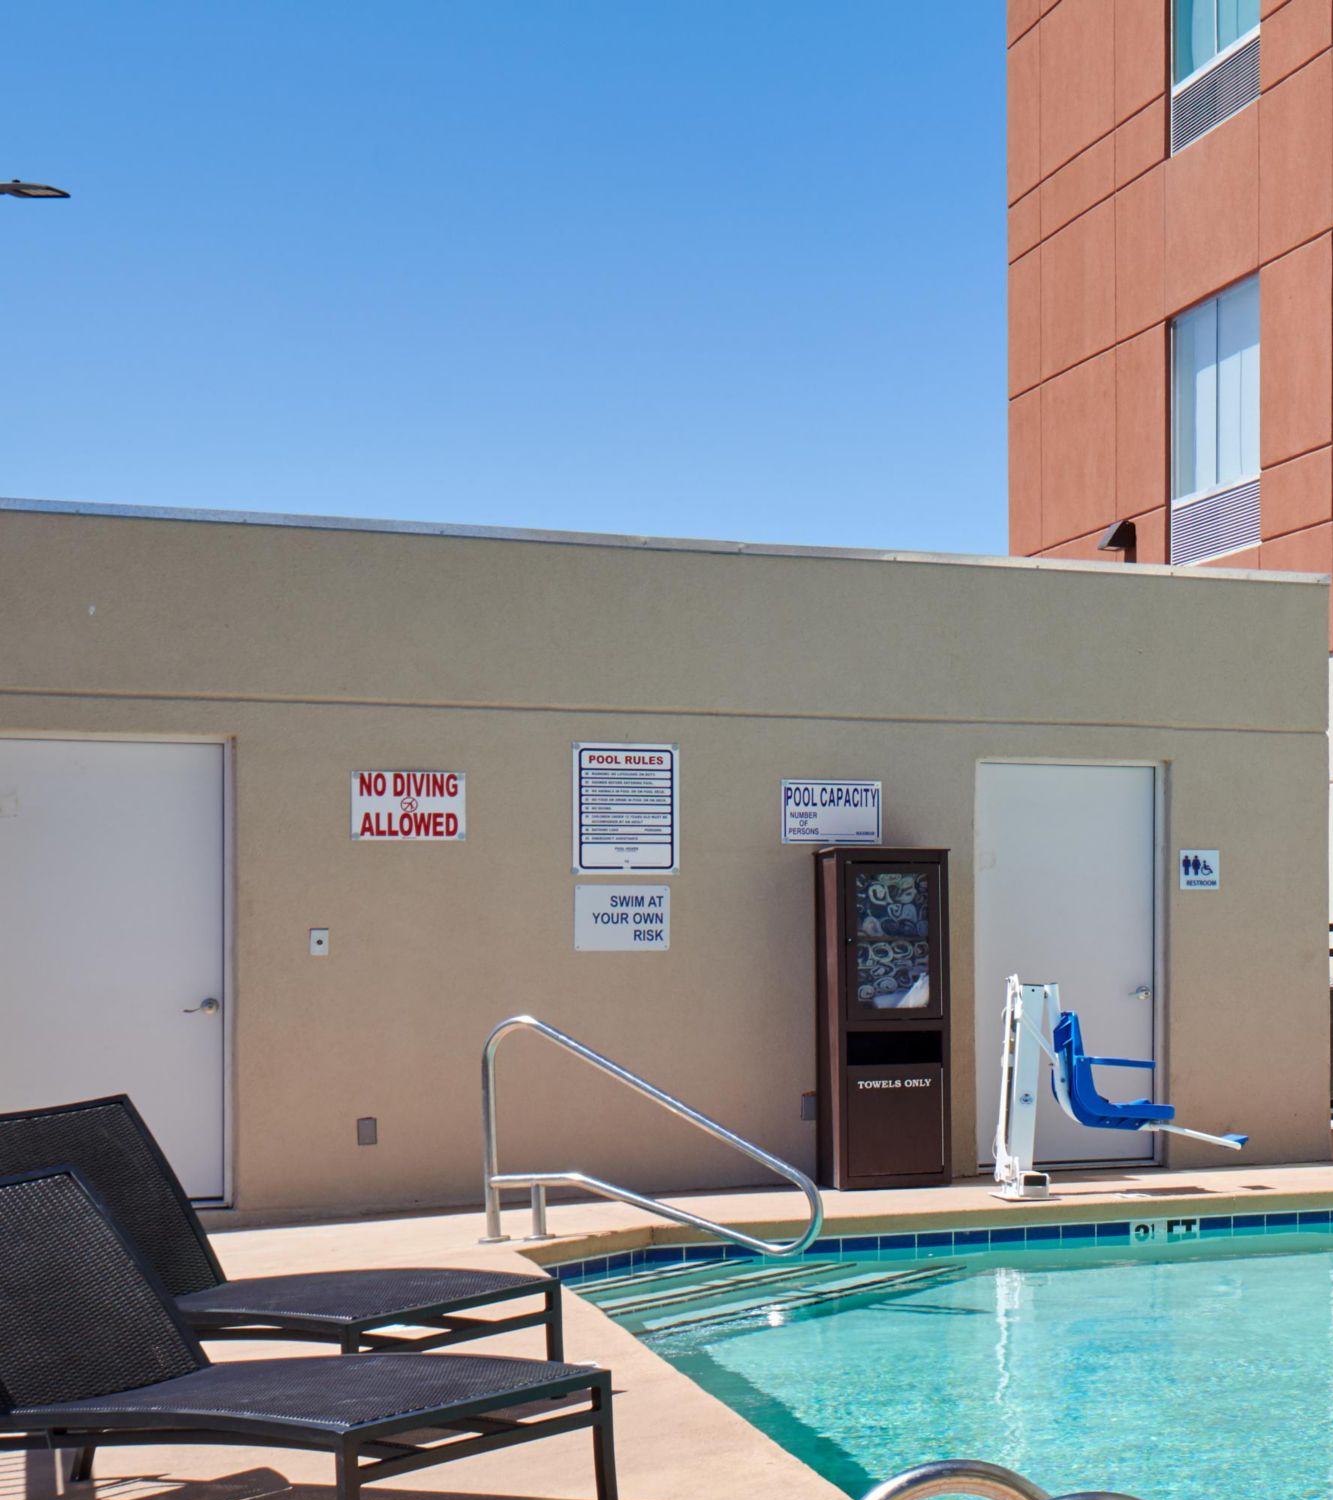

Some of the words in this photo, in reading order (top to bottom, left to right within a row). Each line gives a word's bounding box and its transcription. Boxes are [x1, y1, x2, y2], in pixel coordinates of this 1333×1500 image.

[588, 755, 621, 765] POOL
[624, 756, 664, 765] RULES
[359, 772, 387, 797] NO
[393, 772, 459, 798] DIVING
[786, 787, 817, 807] POOL
[820, 787, 877, 808] CAPACITY
[790, 811, 818, 819] NUMBER
[360, 812, 459, 837] ALLOWED
[799, 819, 808, 827] OF
[788, 827, 820, 835] PERSONS
[610, 895, 645, 908] SWIM
[647, 895, 664, 908] AT
[592, 912, 629, 925] YOUR
[632, 912, 664, 925] OWN
[633, 929, 664, 942] RISK
[857, 1080, 902, 1090] TOWELS
[904, 1078, 932, 1088] ONLY
